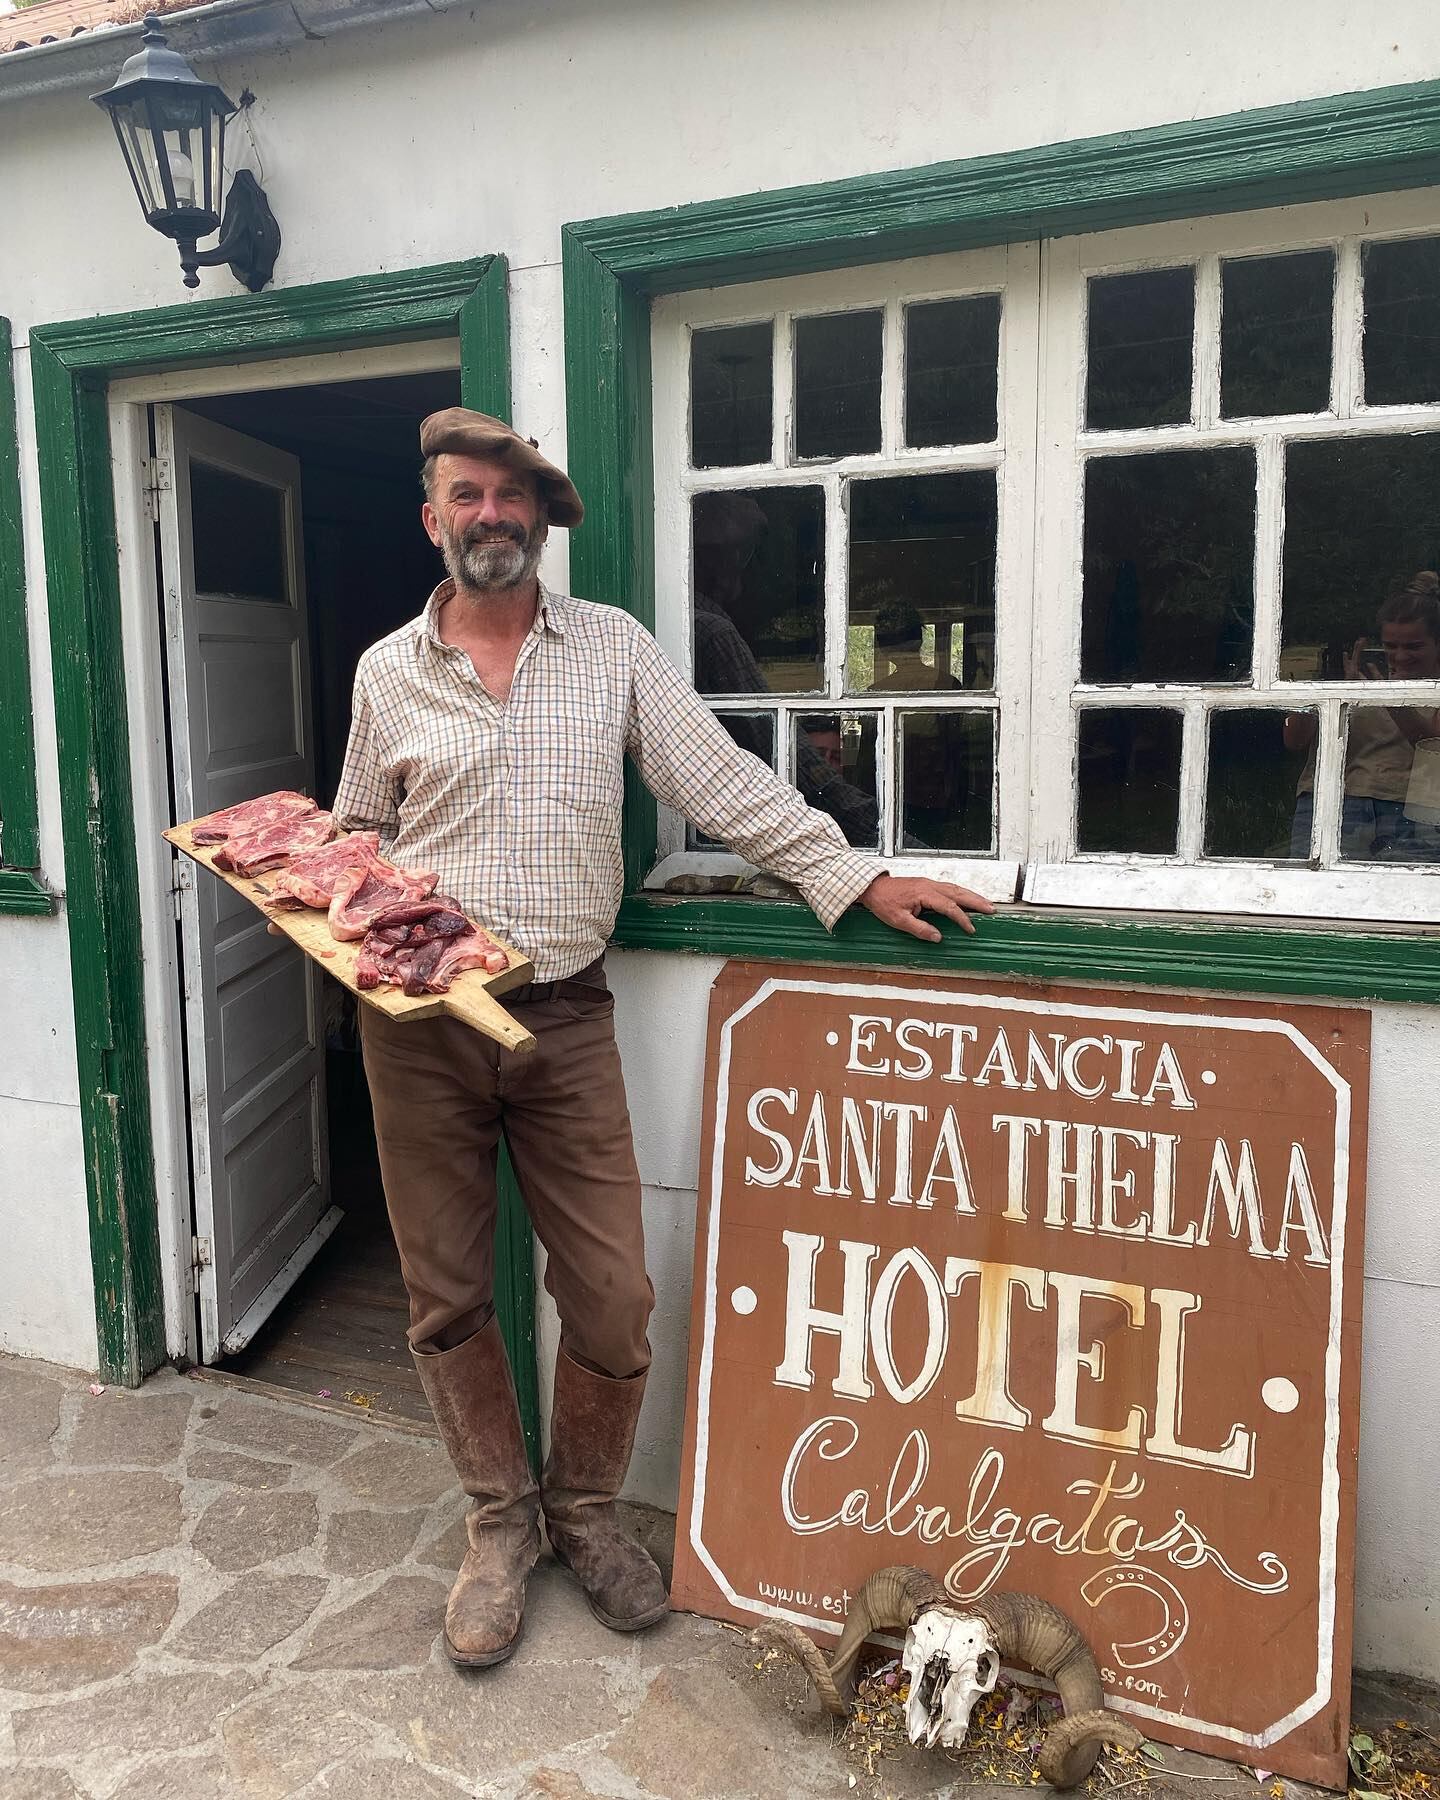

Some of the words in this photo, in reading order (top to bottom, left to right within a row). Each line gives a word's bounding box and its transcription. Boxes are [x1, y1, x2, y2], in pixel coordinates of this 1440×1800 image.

[846, 1014, 1197, 1110] ESTANCIA
[745, 1086, 978, 1216] SANTA
[992, 1114, 1331, 1268] THELMA
[771, 1230, 1256, 1478] HOTEL
[781, 1415, 1289, 1603] Cabalgatas
[758, 1581, 852, 1615] www.est
[1100, 1667, 1166, 1698] ss.com
